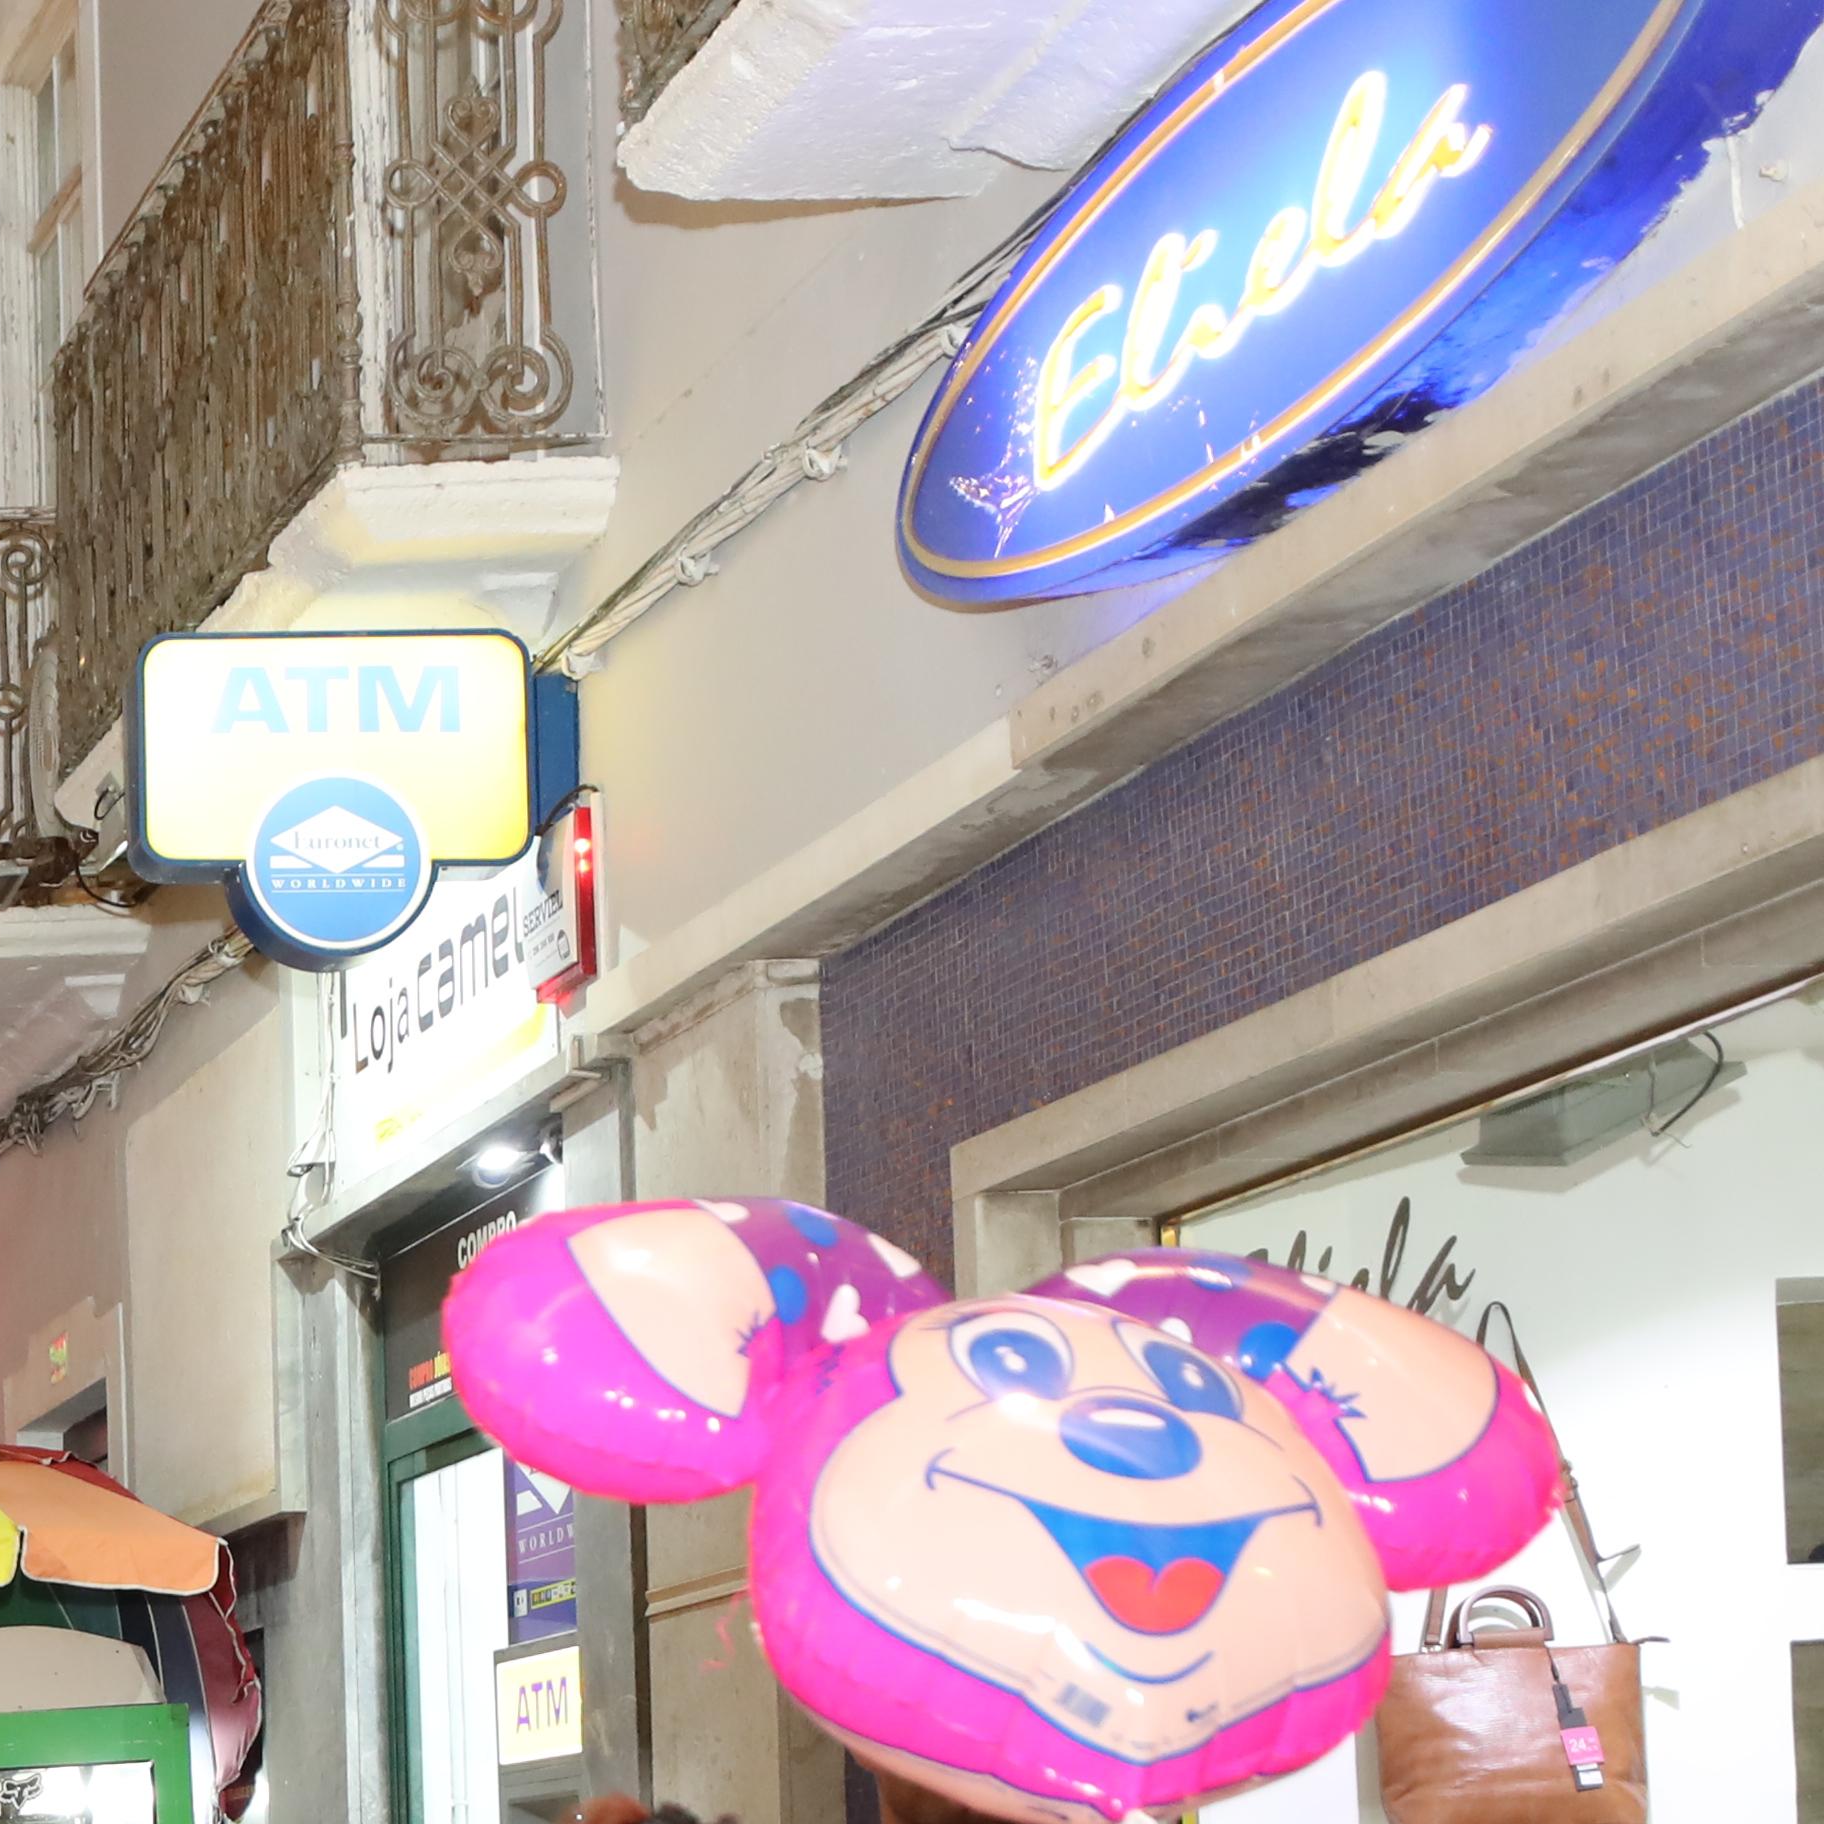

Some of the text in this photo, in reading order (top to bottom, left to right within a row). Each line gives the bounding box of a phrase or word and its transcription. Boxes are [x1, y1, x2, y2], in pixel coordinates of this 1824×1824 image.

[212, 666, 461, 733] ATM
[294, 831, 380, 849] Euronet
[272, 879, 406, 888] WORLDWIDE
[353, 977, 409, 1074] Loja
[516, 1676, 569, 1734] ATM
